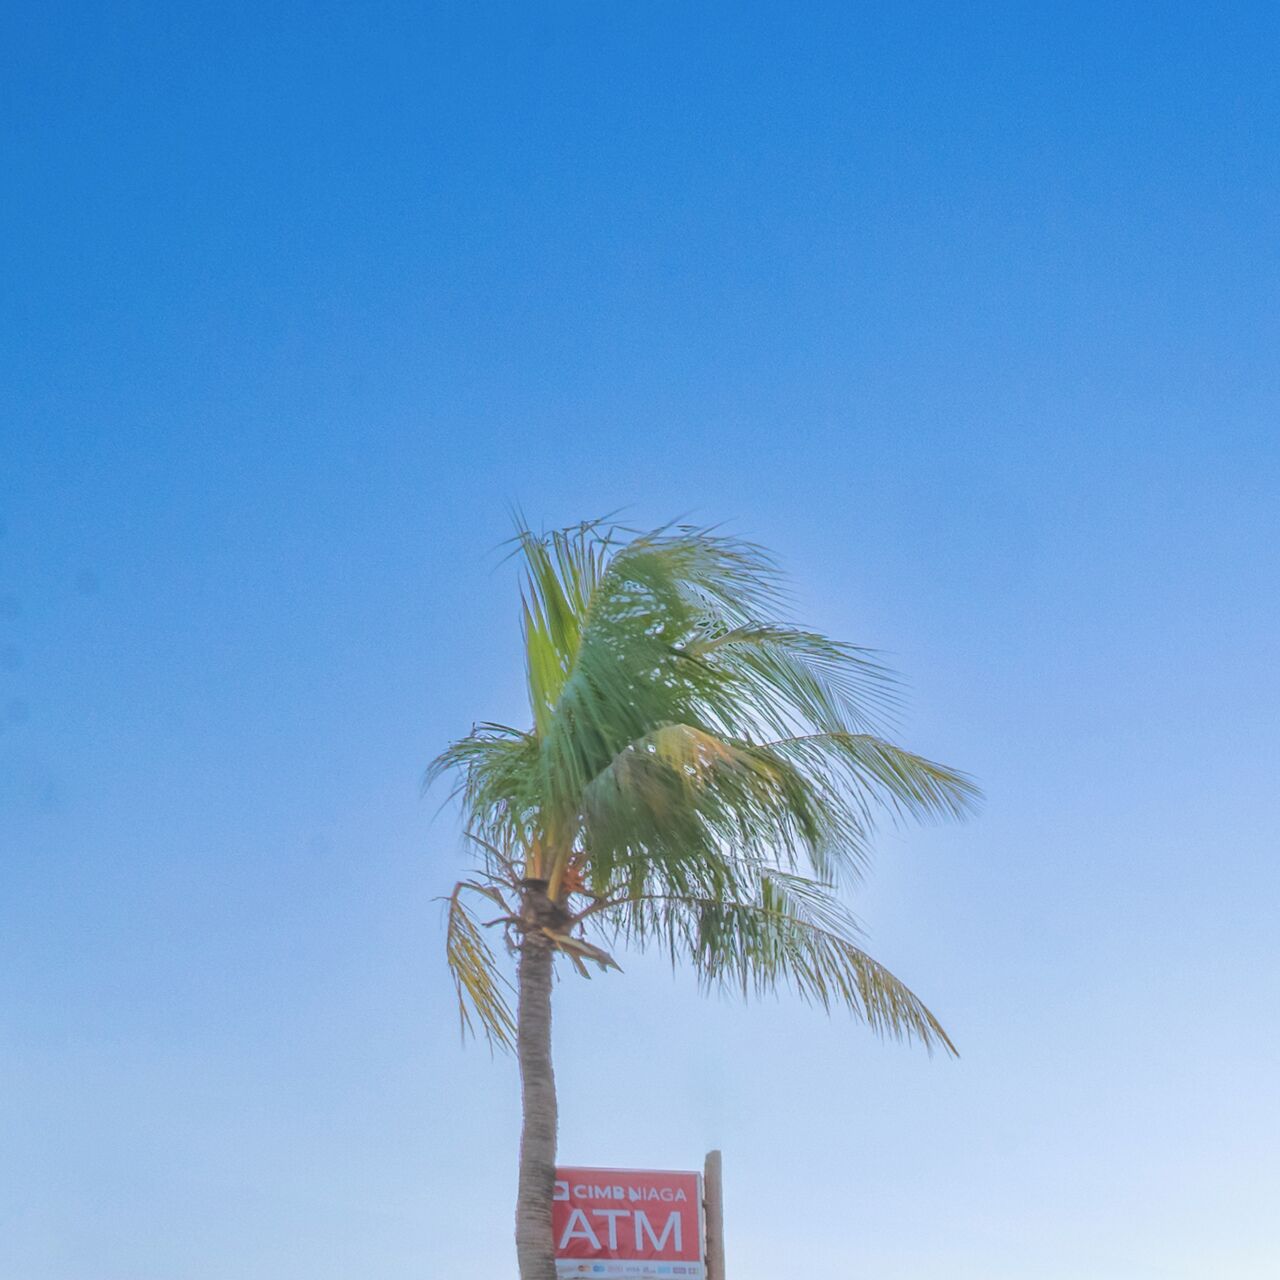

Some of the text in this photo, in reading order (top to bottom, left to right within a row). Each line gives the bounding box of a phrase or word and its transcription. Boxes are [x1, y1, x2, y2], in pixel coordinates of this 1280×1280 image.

[573, 1184, 687, 1202] CIMB NIAGA
[559, 1208, 683, 1252] ATM
